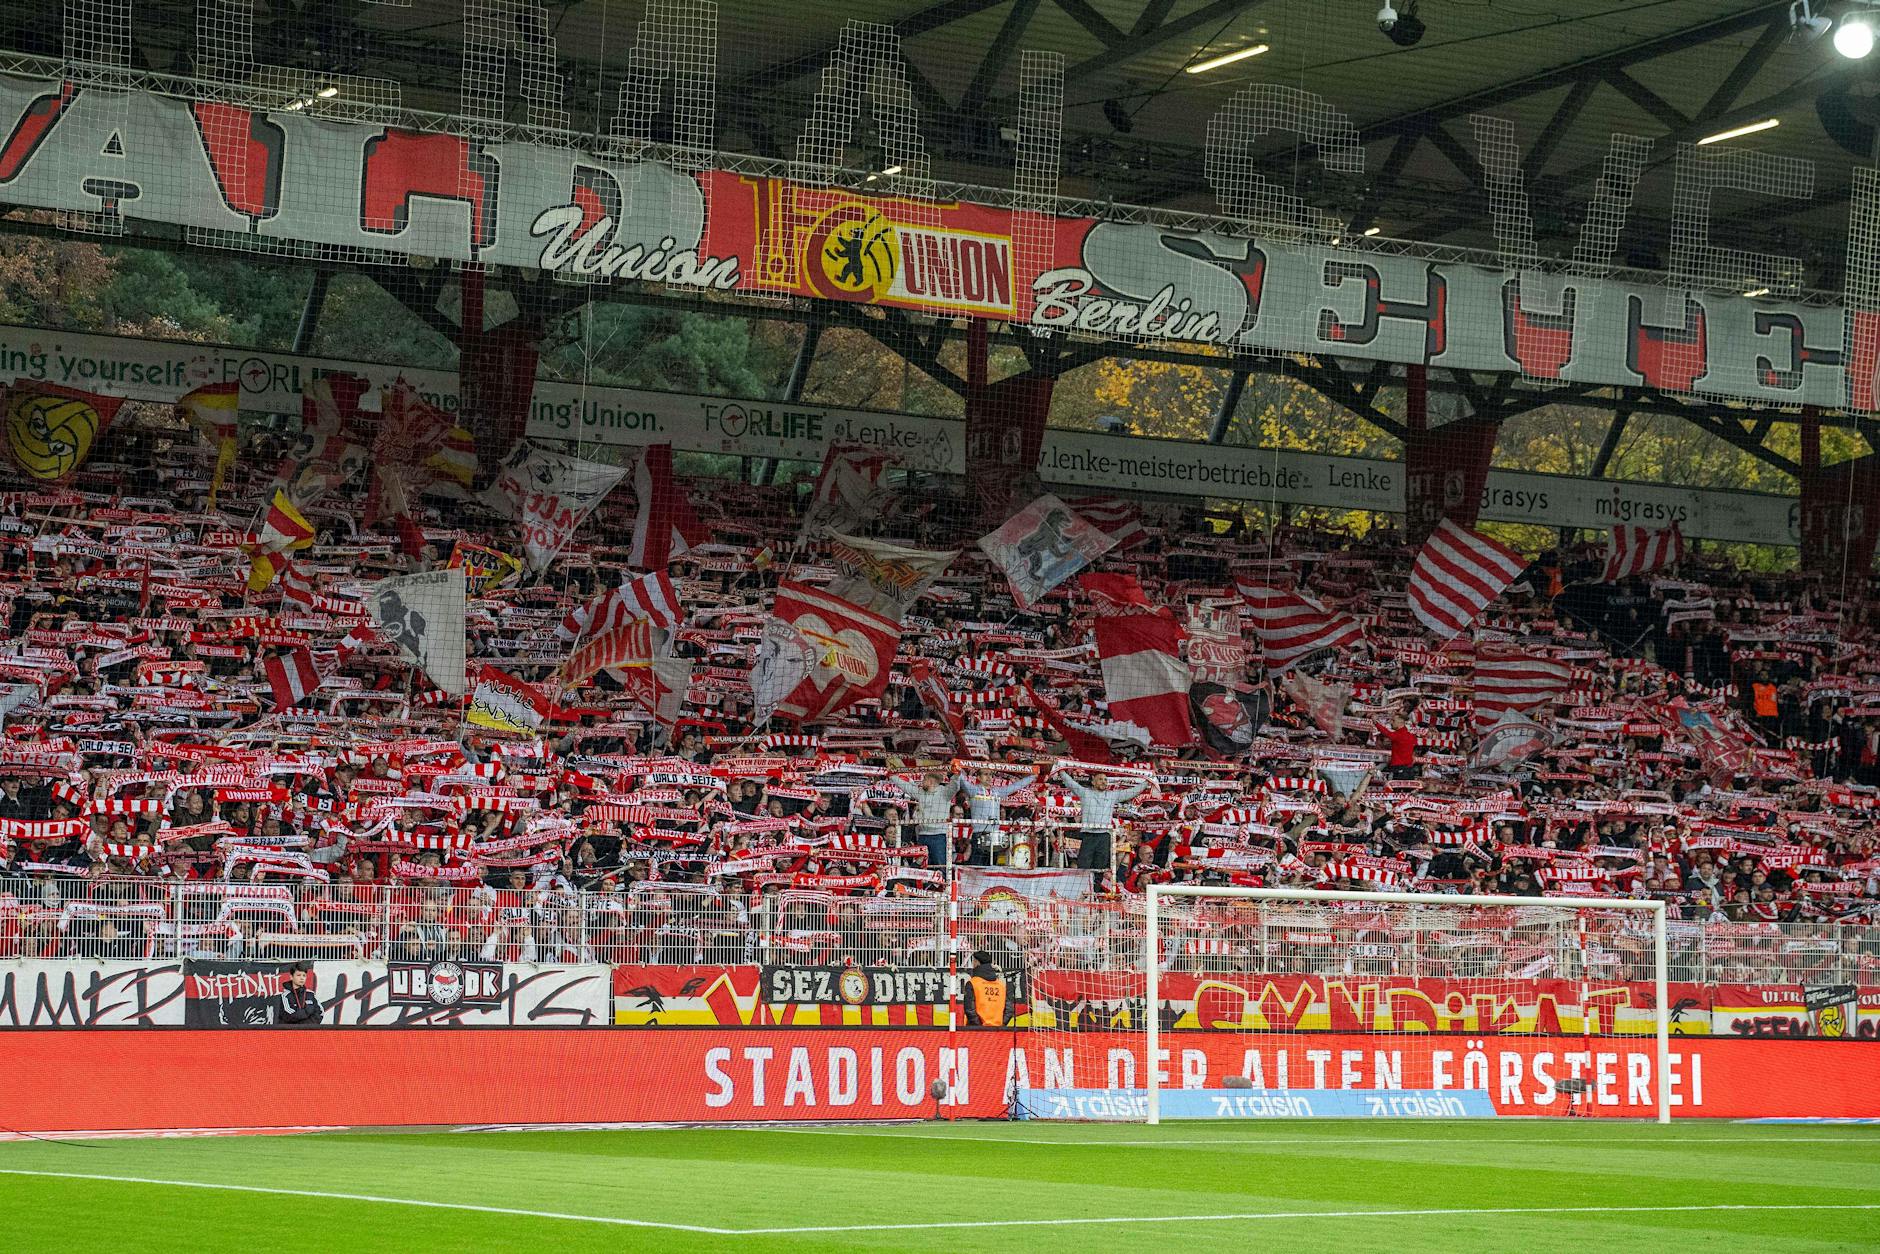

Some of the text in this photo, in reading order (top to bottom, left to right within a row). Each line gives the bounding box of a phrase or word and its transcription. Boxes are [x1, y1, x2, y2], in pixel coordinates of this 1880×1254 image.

[0, 78, 1845, 410] ALD SEITE
[532, 204, 741, 291] Union
[902, 230, 1011, 307] UNION
[1032, 268, 1226, 344] Berlin
[58, 348, 192, 388] yourself.
[583, 402, 665, 432] Union.
[846, 419, 918, 448] Lenke
[1328, 464, 1392, 491] Lenke
[1480, 487, 1549, 514] grasys
[1596, 487, 1687, 521] migrasys
[837, 651, 869, 678] UNION
[688, 690, 707, 703] UNION
[226, 789, 273, 800] UNIONER
[471, 788, 496, 797] SERN
[653, 774, 716, 787] WALD SEITE
[866, 788, 896, 799] WALD
[245, 837, 286, 846] BERLIN
[650, 828, 683, 838] UNION
[808, 878, 818, 886] FC
[819, 878, 845, 887] UNION
[1544, 867, 1612, 882] UNION
[390, 966, 429, 998] UB
[464, 966, 500, 999] DK
[772, 970, 840, 1002] SEZ.
[984, 986, 1000, 997] 282
[704, 1040, 1702, 1108] STADION AN DER ALTEN FÖRSTEREI
[1243, 1089, 1315, 1118] raisin
[1394, 1090, 1465, 1119] raisin
